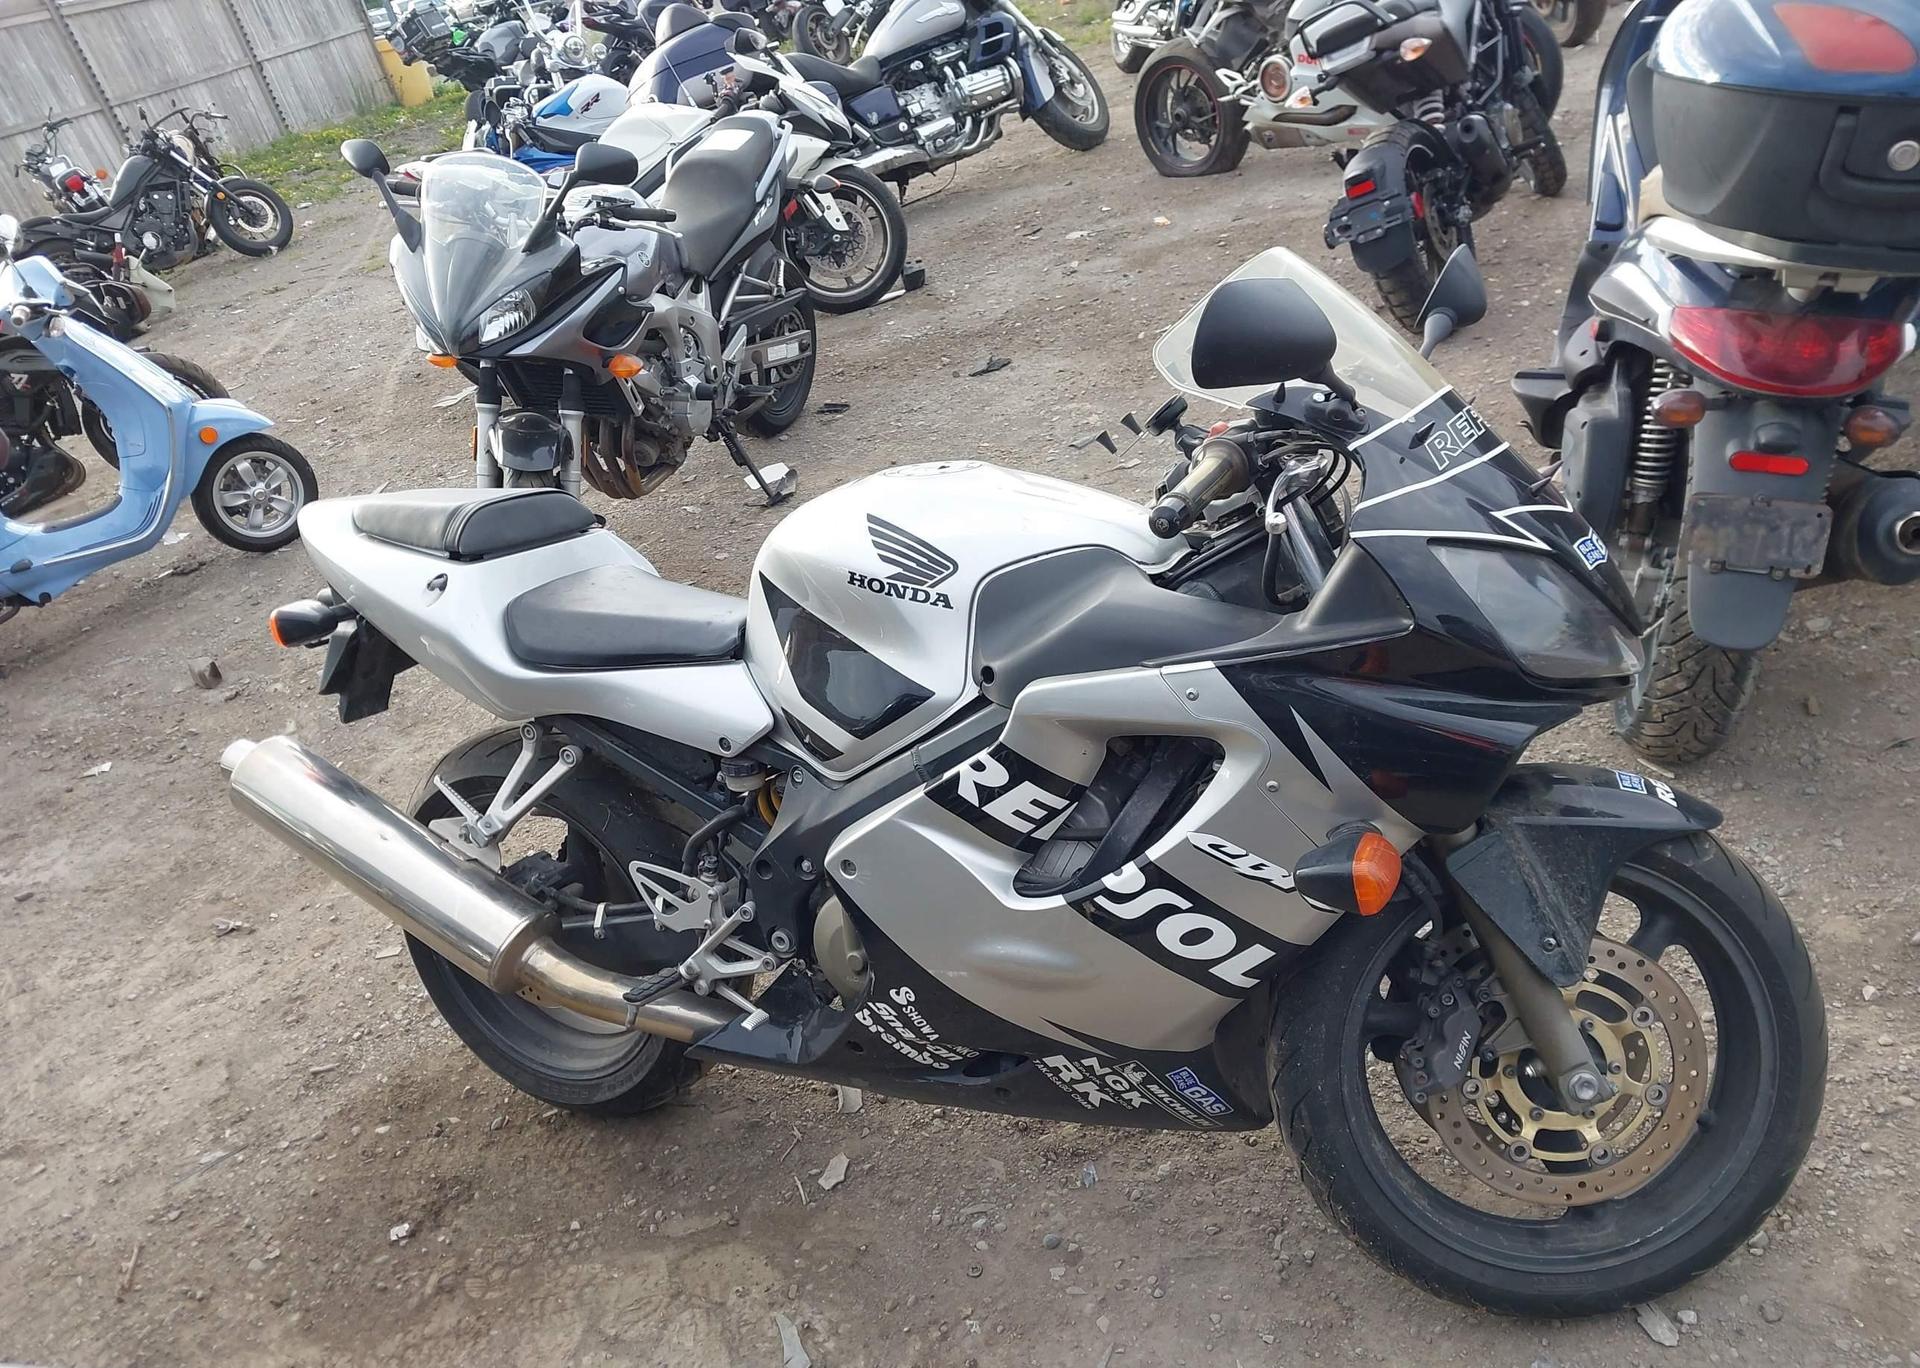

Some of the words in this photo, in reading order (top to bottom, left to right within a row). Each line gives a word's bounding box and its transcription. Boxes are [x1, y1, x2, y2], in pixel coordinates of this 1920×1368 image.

[847, 570, 955, 611] HONDA
[854, 1007, 950, 1070] brembo
[902, 1004, 940, 1041] SHOWA
[1041, 1054, 1118, 1109] RK
[1080, 1056, 1153, 1109] NGK
[1179, 1070, 1196, 1086] BLUE
[1146, 1084, 1215, 1126] MICHELIN
[1183, 1086, 1226, 1114] GAS
